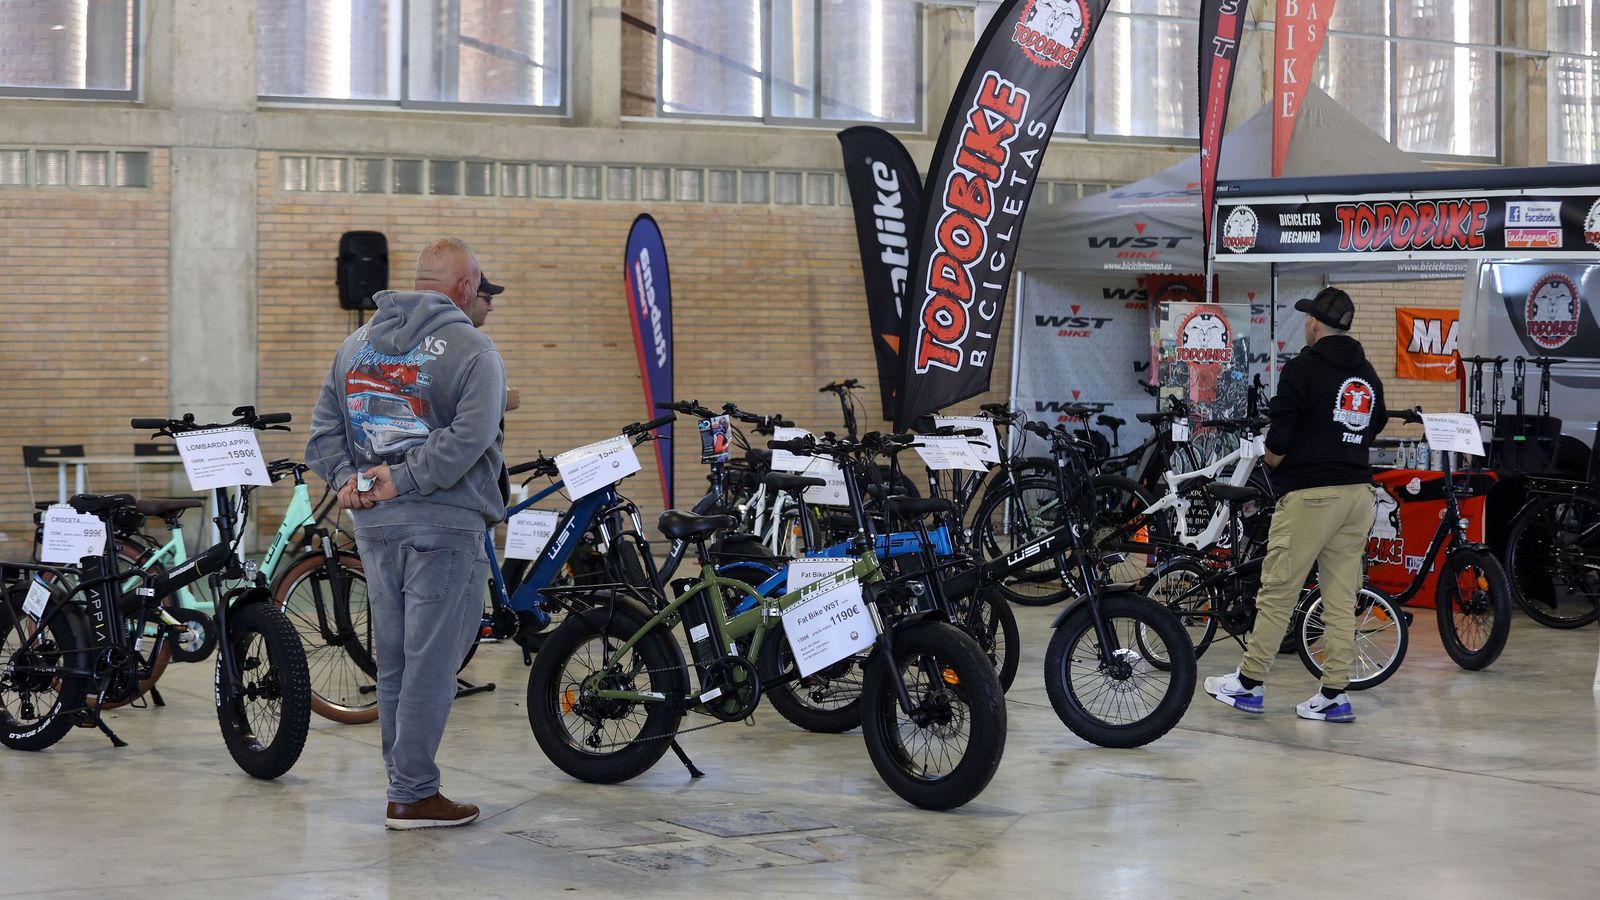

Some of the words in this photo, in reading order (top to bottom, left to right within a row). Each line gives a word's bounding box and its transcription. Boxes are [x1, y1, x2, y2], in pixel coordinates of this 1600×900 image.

[1212, 0, 1240, 58] ST
[1012, 22, 1078, 69] TODOBIKE
[915, 70, 1031, 374] TODOBIKE
[1279, 213, 1321, 227] BICICLETAS
[1525, 211, 1557, 223] facebook
[1336, 199, 1489, 251] TODOBIKE
[872, 160, 910, 319] atlike
[969, 119, 1047, 368] BICICLETAS
[1088, 235, 1193, 249] WST
[1279, 230, 1321, 244] MECANICA
[1508, 230, 1548, 247] instagram
[1116, 250, 1160, 259] BIKE
[1102, 287, 1148, 301] WS
[1125, 302, 1149, 310] BIK
[1251, 303, 1287, 315] ST
[1035, 315, 1113, 329] WST
[1526, 320, 1578, 337] TODOBIKE
[1057, 329, 1093, 338] BIKE
[1407, 318, 1460, 354] MA
[1176, 347, 1233, 363] TODOBIKE
[186, 441, 228, 452] LOMBARDO
[229, 439, 251, 447] APPIA
[1342, 431, 1364, 445] TEAM
[227, 449, 257, 459] 1590€
[50, 516, 80, 524] CROCETA
[83, 528, 103, 538] 999€
[547, 515, 575, 560] WST
[1007, 535, 1056, 567] WST
[1368, 537, 1405, 566] BIKE
[801, 571, 811, 579] Fat
[812, 571, 827, 579] Bike
[90, 589, 107, 642] APPIA
[797, 615, 809, 626] Fat
[808, 609, 823, 620] Bike
[823, 600, 840, 612] WST
[829, 604, 860, 626] 1190€
